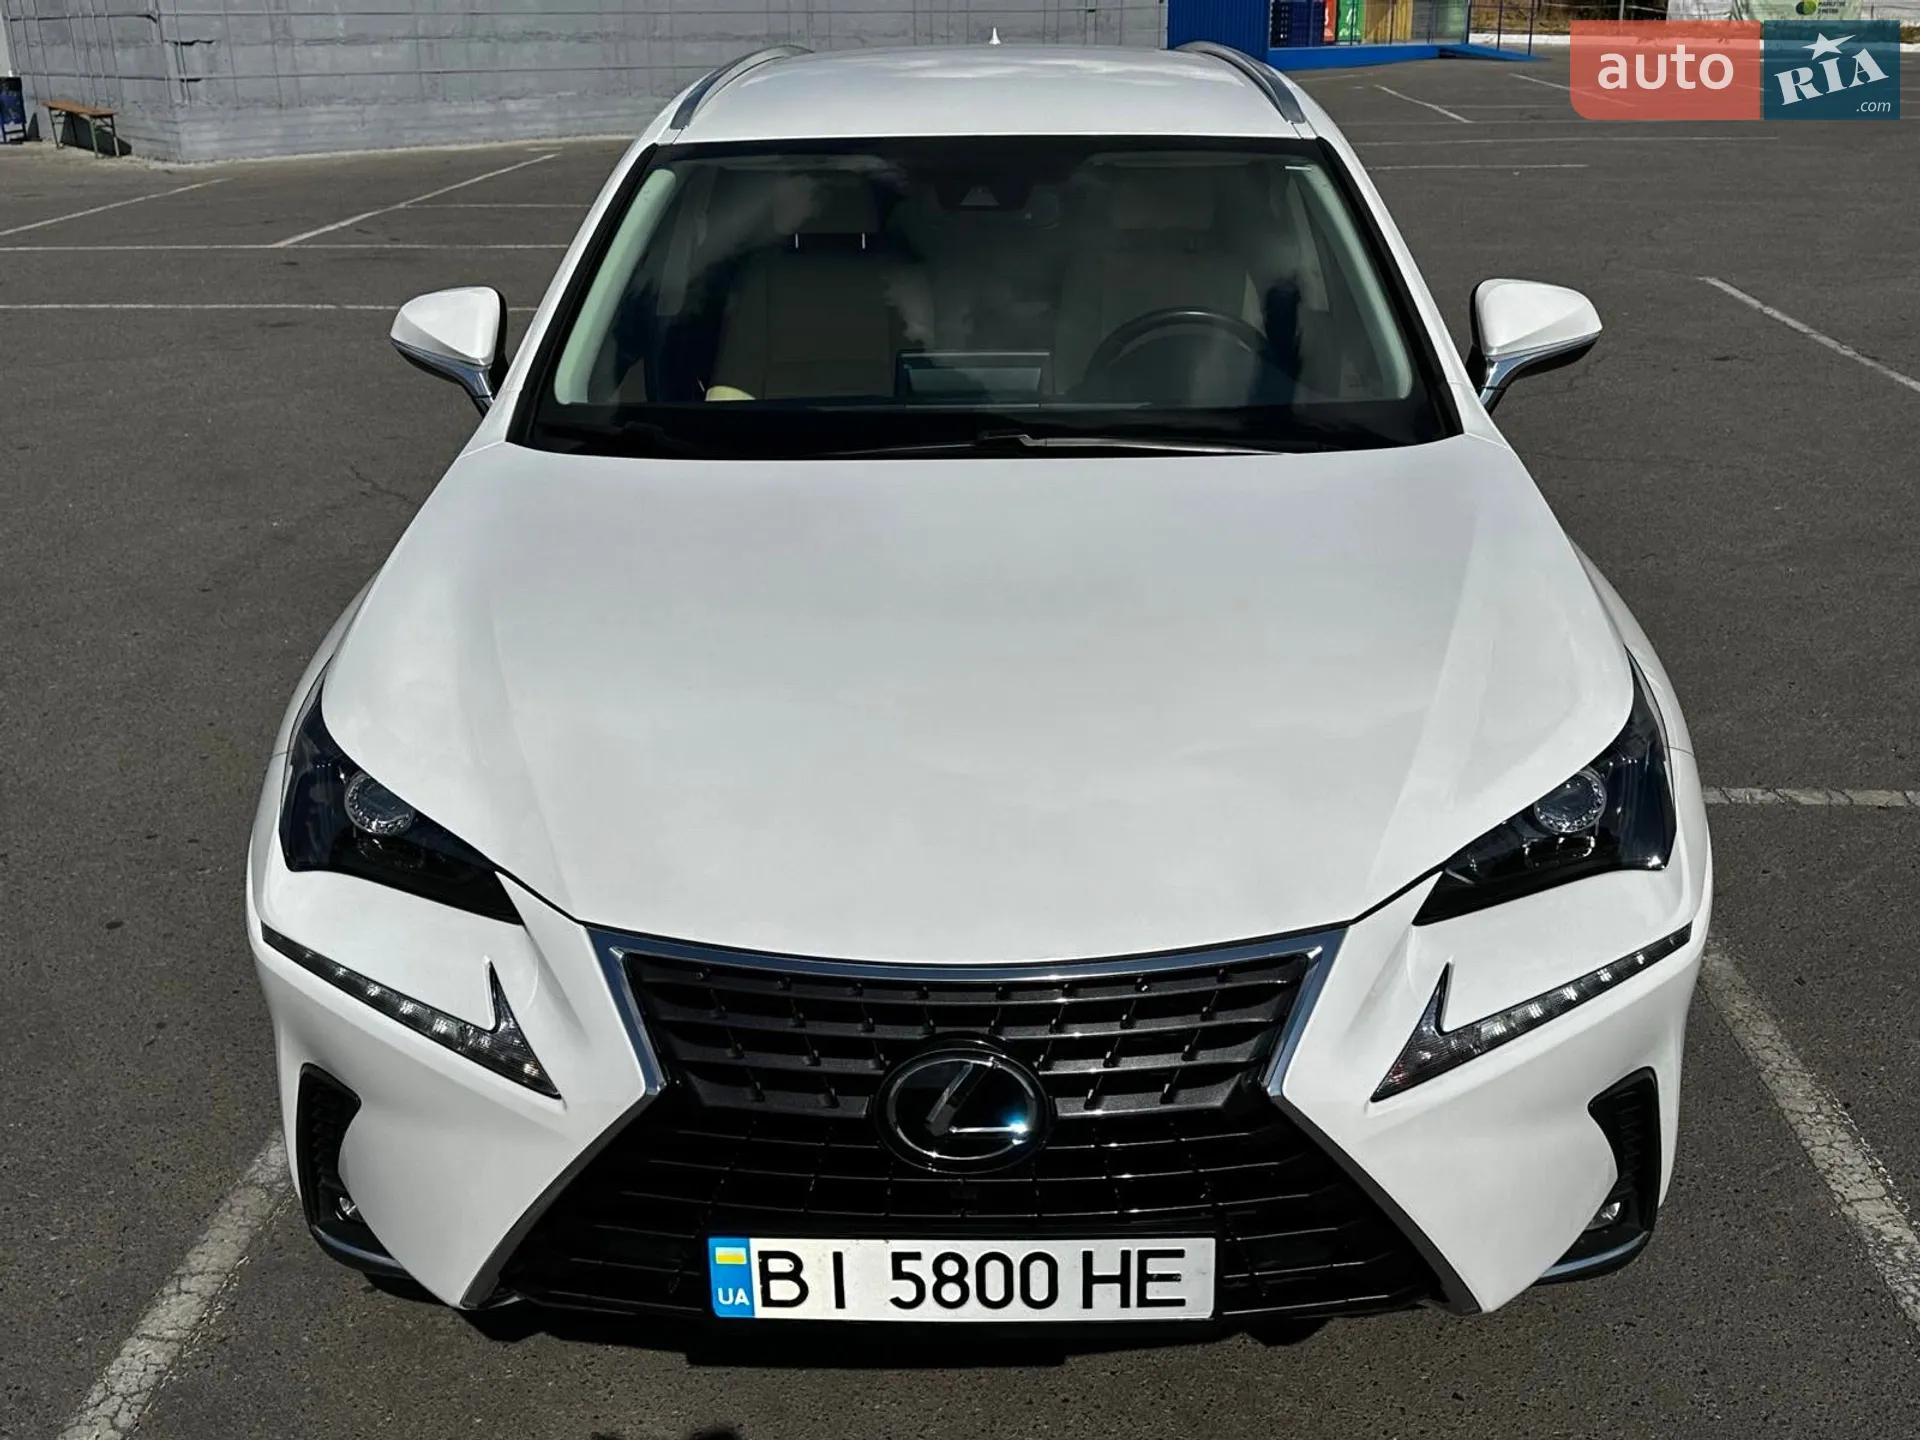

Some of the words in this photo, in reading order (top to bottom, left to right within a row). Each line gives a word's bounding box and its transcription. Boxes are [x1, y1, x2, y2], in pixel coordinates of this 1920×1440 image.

[718, 1287, 750, 1306] UA
[758, 1250, 848, 1308] BI
[889, 1250, 1059, 1310] 5800
[1081, 1248, 1187, 1309] HE
